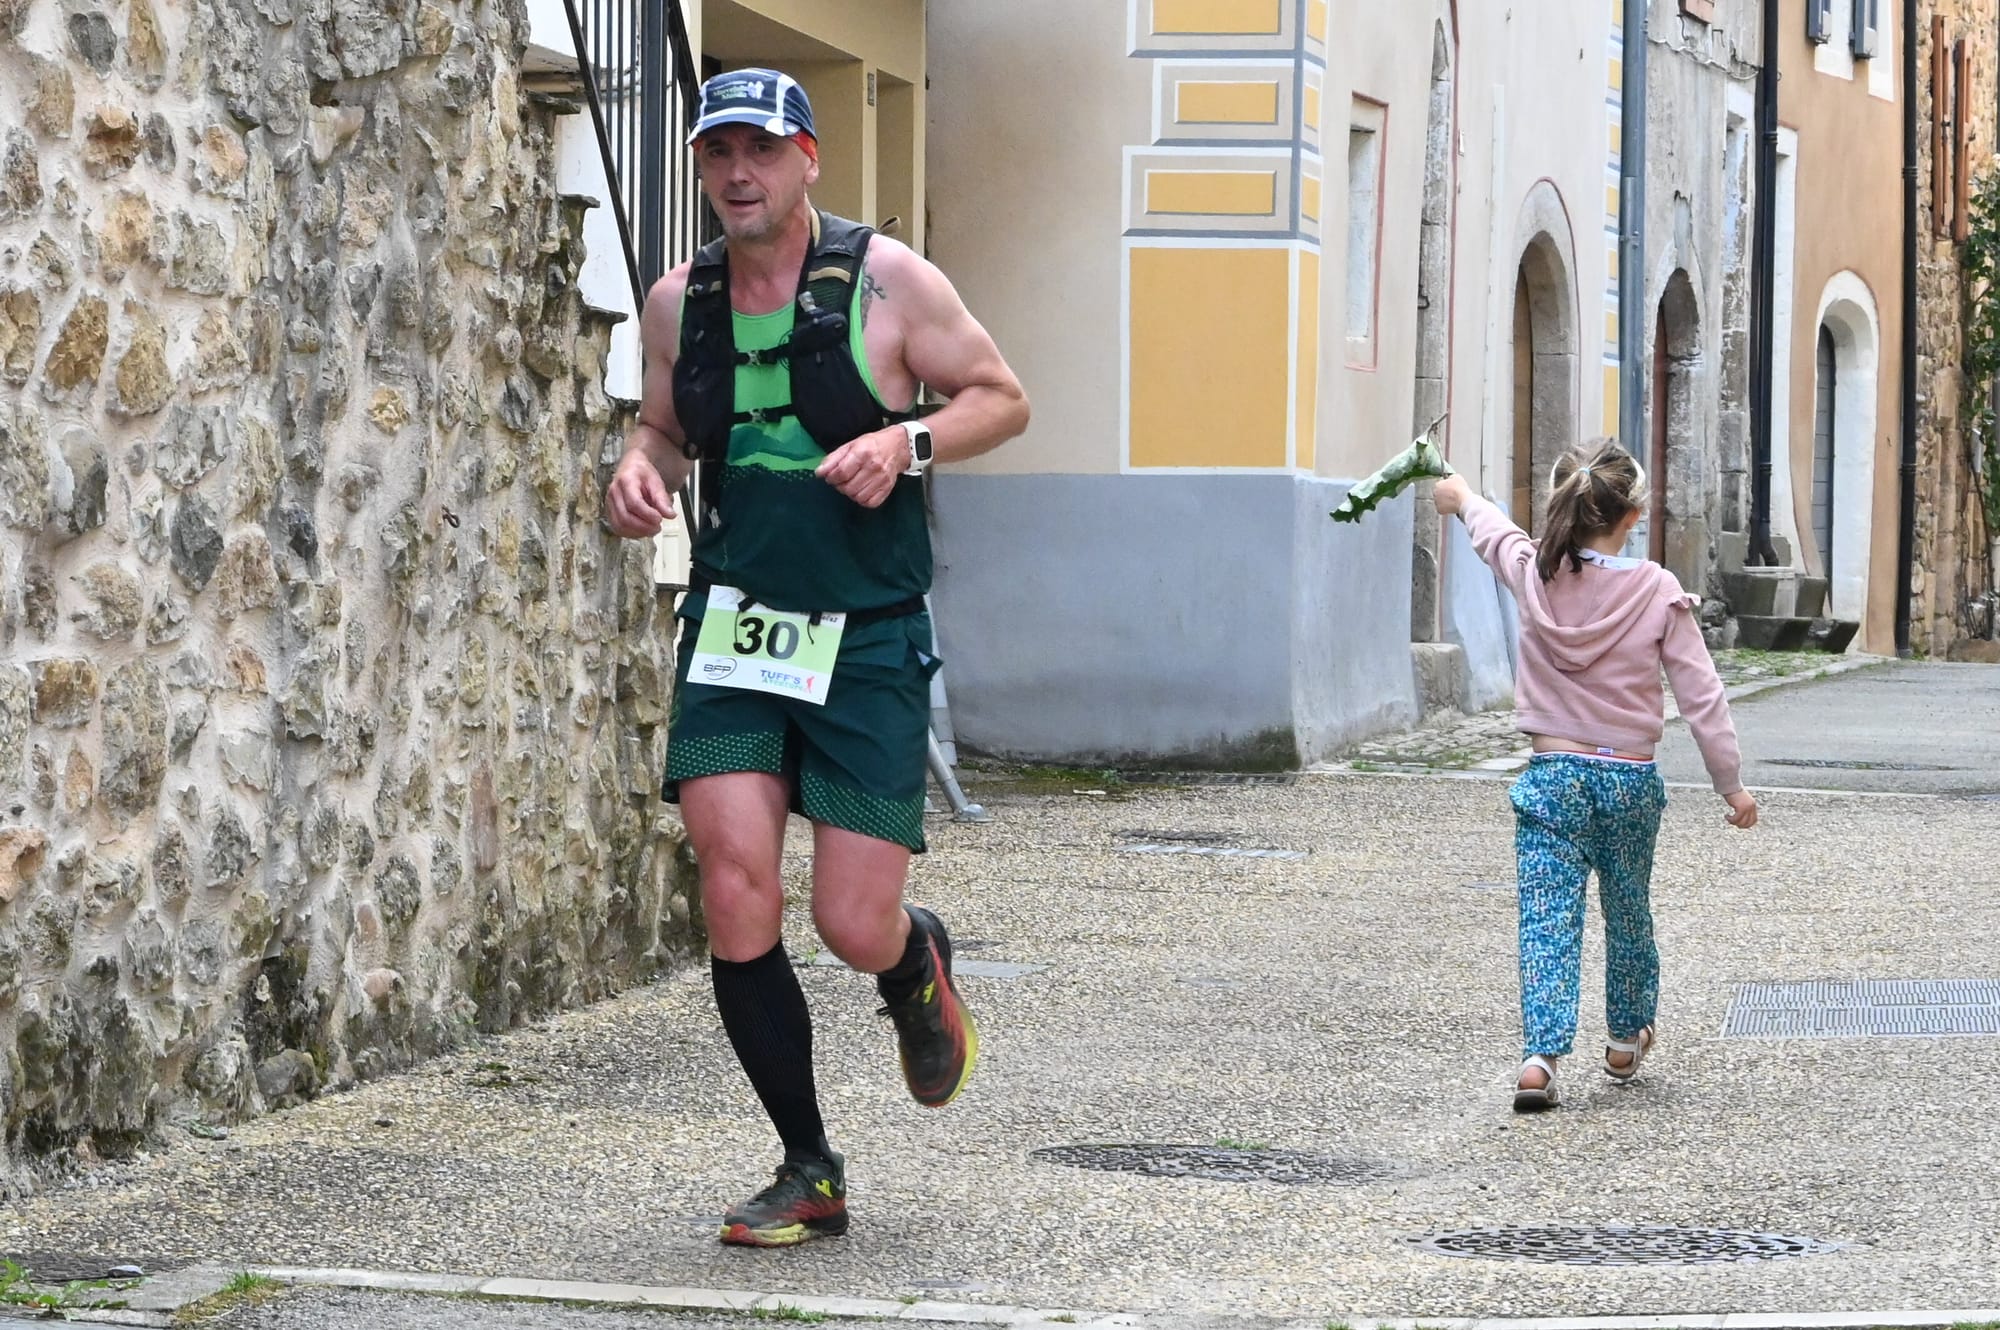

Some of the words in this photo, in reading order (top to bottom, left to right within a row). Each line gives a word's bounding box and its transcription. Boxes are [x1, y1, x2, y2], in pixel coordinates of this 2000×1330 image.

[733, 617, 799, 660] 30
[703, 663, 731, 674] BFP
[760, 669, 801, 685] TUFF'S
